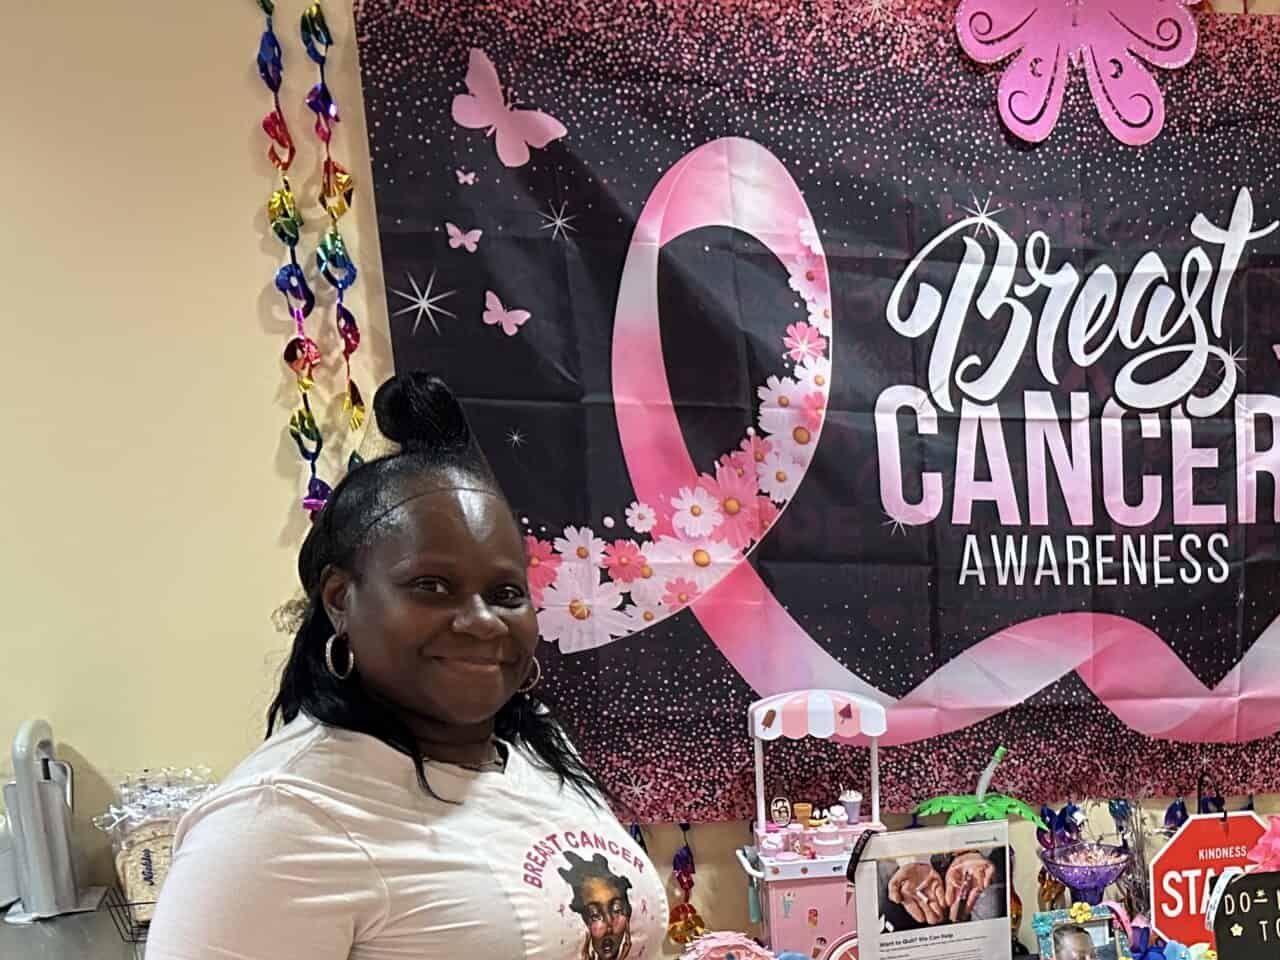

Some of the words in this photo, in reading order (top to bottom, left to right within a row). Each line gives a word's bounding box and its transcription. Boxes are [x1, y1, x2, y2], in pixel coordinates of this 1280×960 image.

[886, 186, 1280, 417] Breast
[958, 532, 1230, 586] AWARENESS
[522, 833, 563, 889] BREAST
[564, 830, 645, 874] CANCER
[1198, 846, 1247, 860] KINDNESS
[1224, 891, 1250, 915] DO
